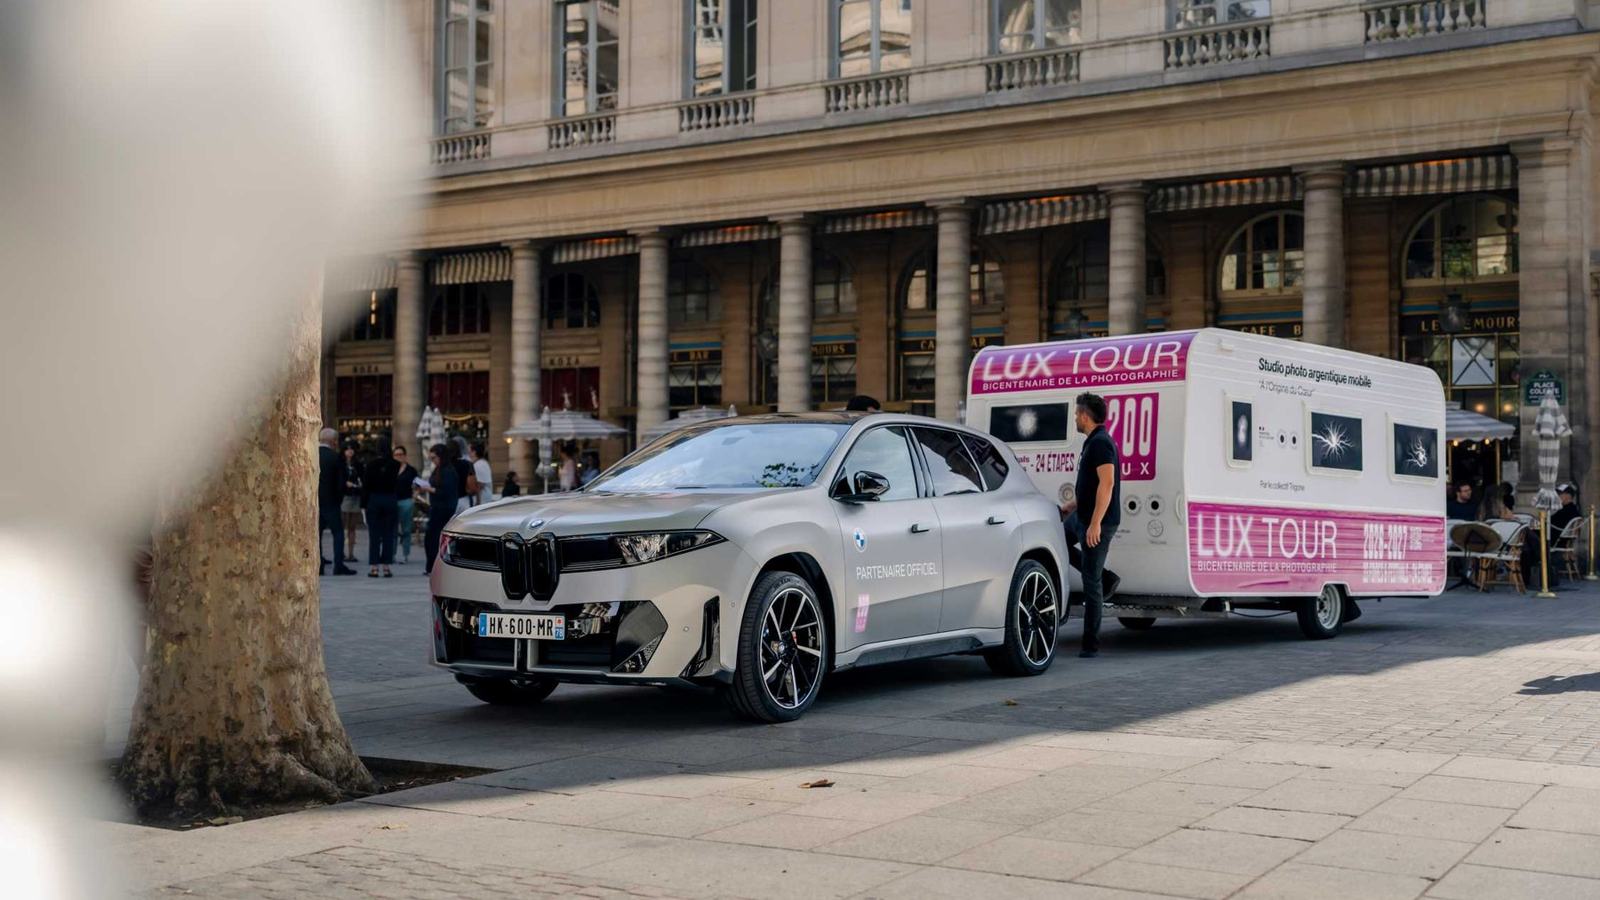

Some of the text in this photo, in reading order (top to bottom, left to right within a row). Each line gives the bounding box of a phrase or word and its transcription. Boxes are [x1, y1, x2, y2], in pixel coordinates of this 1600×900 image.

[1421, 319, 1439, 331] LE
[982, 341, 1182, 381] LUX TOUR
[982, 369, 1178, 391] BICENTENAIRE DE LA PHOTOGRAPHIE
[1258, 358, 1372, 388] Studio photo argentique mobile
[1107, 397, 1153, 457] 200
[1036, 454, 1045, 472] 24
[1121, 462, 1149, 475] UX
[1198, 512, 1338, 559] LUX TOUR
[856, 562, 938, 580] PARTENAIRE OFFICIEL
[1198, 560, 1337, 573] BICENTENAIRE DE LA PHOTOGRAPHIE
[489, 617, 553, 637] HK-600-MR
